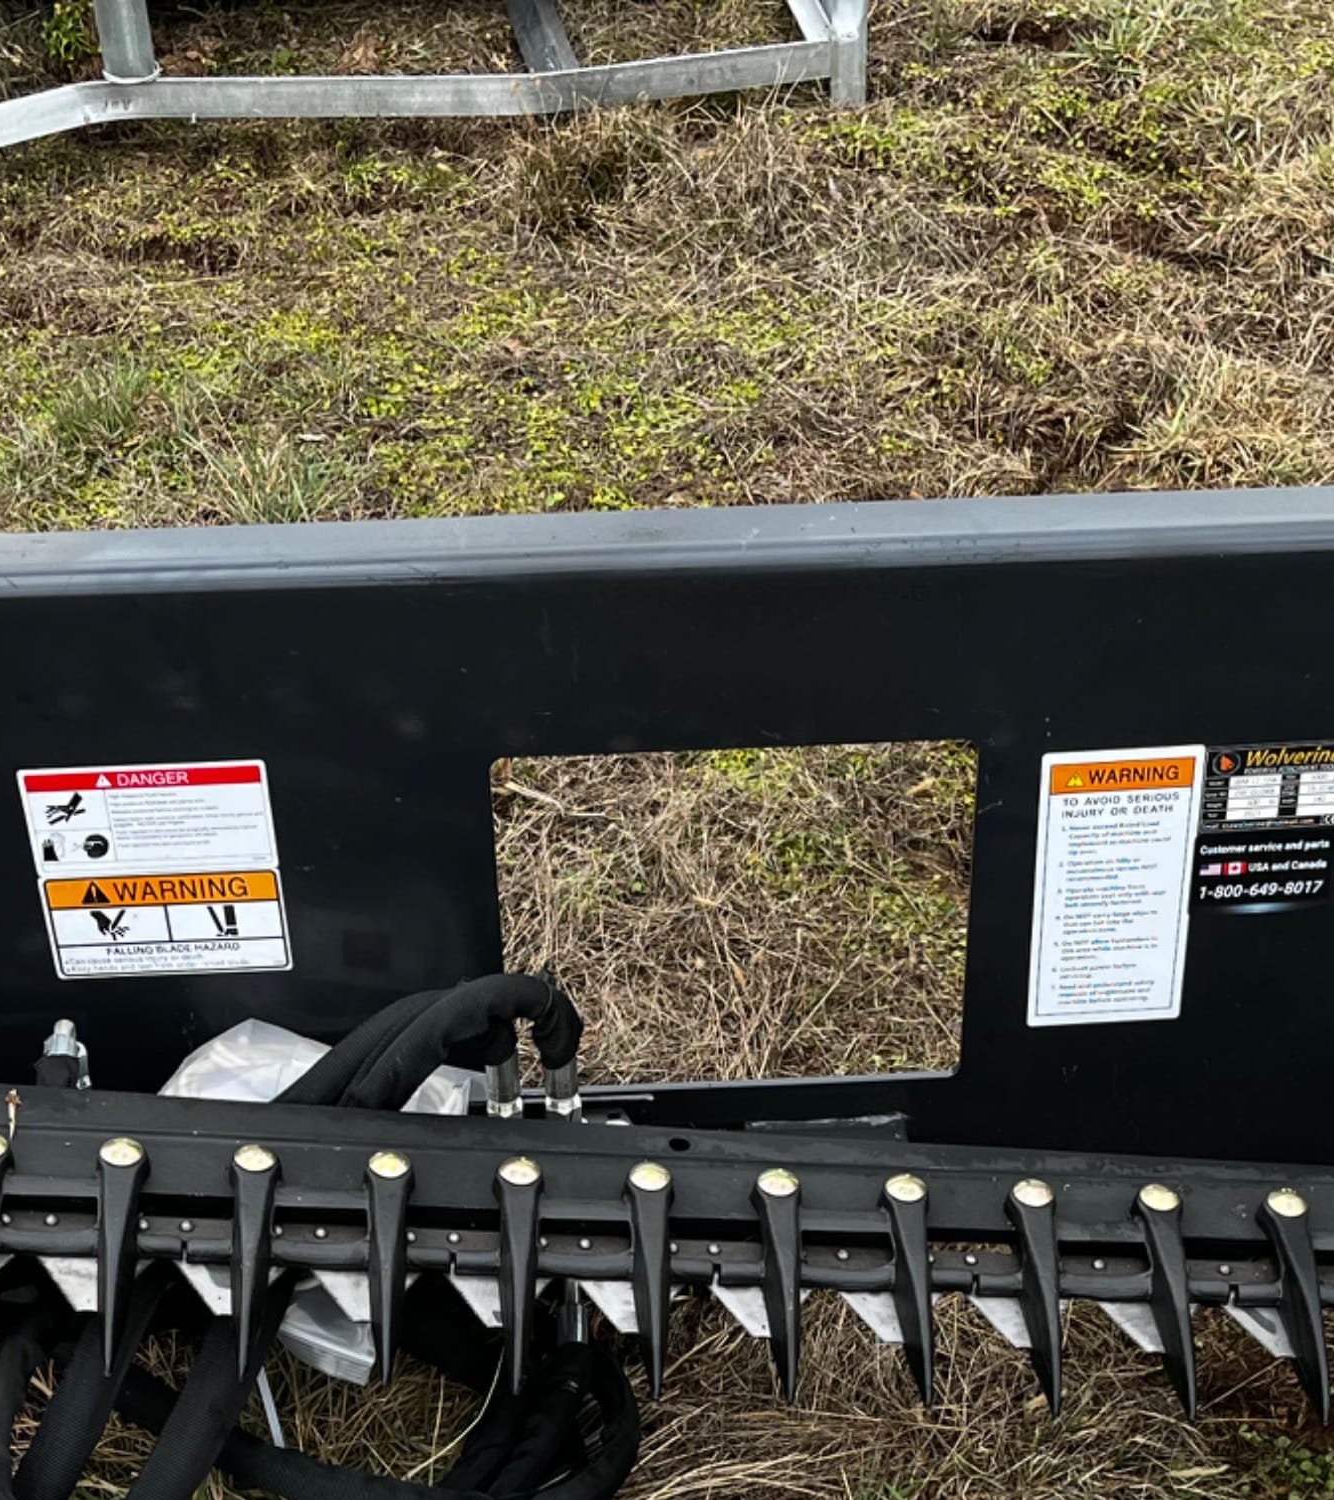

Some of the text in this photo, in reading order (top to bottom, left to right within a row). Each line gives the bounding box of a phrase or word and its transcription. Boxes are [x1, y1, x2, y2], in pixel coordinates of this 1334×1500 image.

[117, 771, 189, 787] DANGER
[1088, 765, 1179, 784] WARNING
[1063, 792, 1180, 807] TO AVOID SERIOUS
[1062, 804, 1173, 819] INJURY OR DEATH
[1200, 839, 1330, 855] Customer service and parts
[1248, 860, 1328, 873] USA and Canada
[113, 876, 249, 901] WARNING
[1199, 880, 1324, 899] 1-800-649-8017
[106, 942, 241, 956] FALLING BLADE HAZARD
